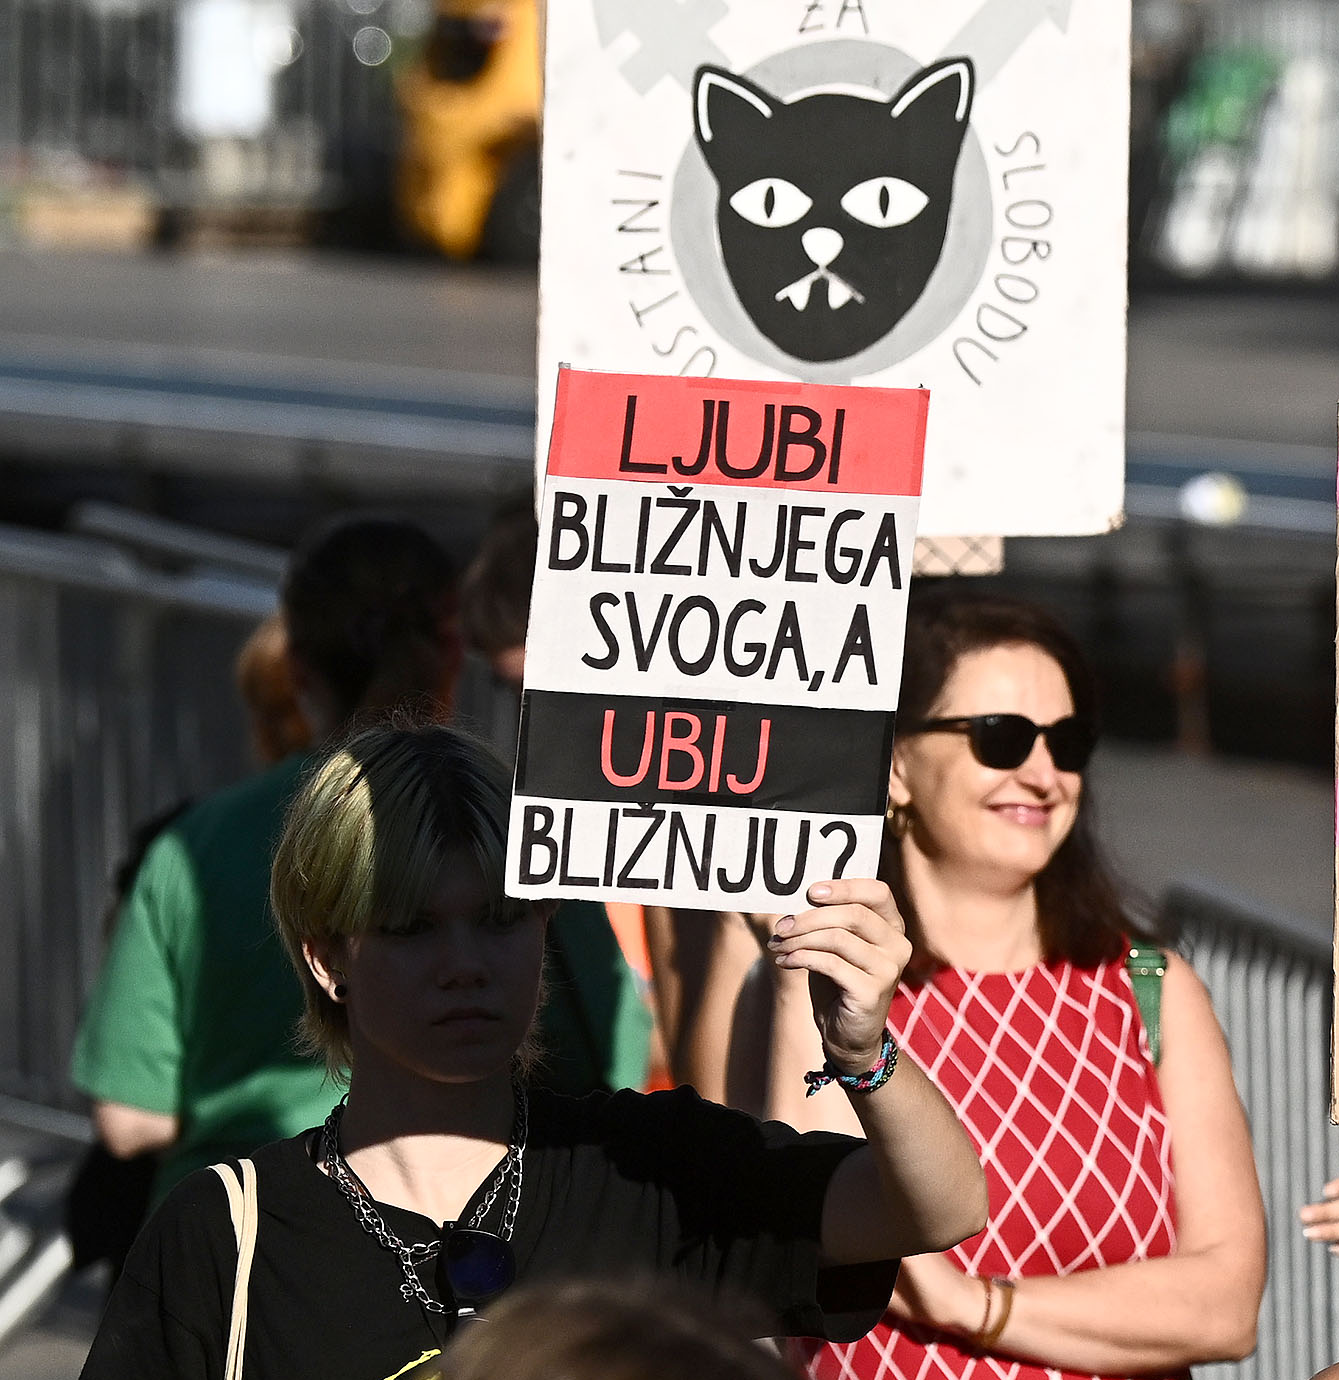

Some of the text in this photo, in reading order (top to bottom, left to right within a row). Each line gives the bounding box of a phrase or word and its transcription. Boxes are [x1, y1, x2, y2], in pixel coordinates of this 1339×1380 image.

[953, 131, 1053, 386] SLOBODU
[618, 395, 846, 484] LJUBI
[547, 485, 902, 590] BLIŽNJEGA
[832, 604, 878, 686] A
[600, 708, 772, 794] UBIJ
[518, 802, 857, 896] BLIŽNJU?
